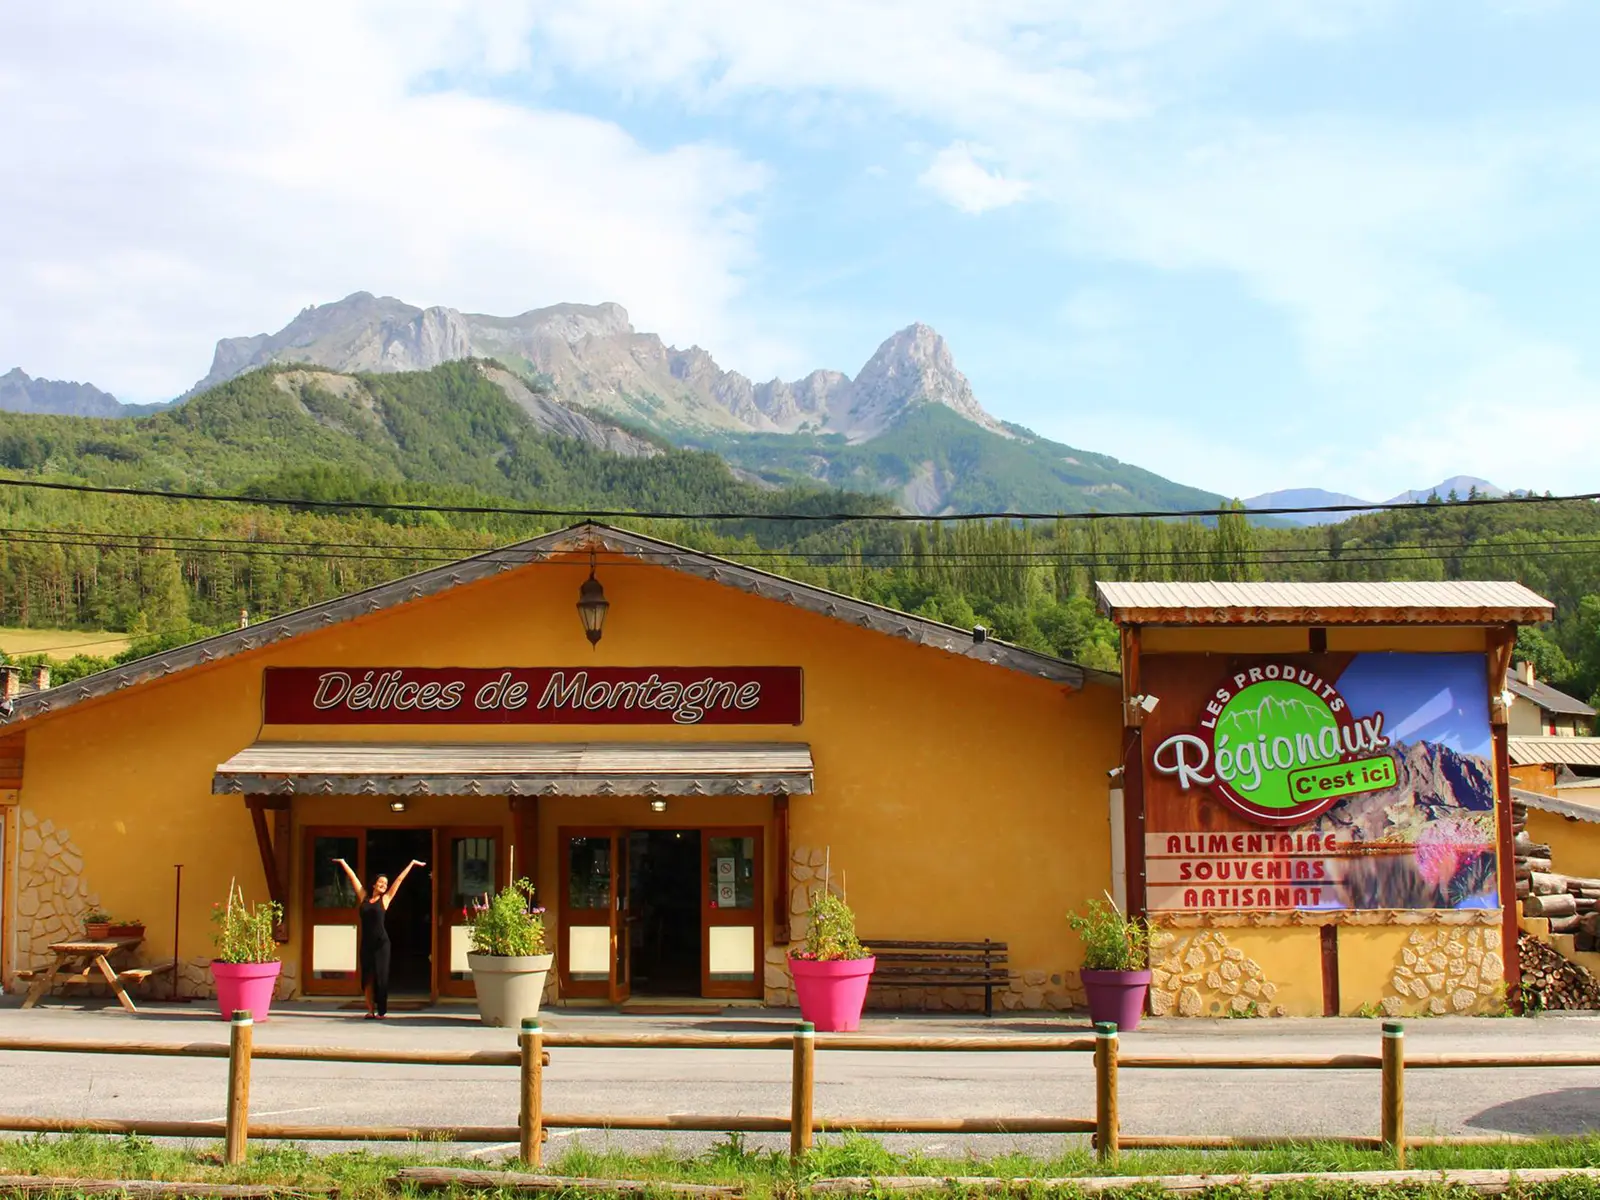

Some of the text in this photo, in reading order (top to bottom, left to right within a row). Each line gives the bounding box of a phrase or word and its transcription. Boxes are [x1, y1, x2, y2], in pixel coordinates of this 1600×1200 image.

[312, 670, 761, 724] Délices de Montagne
[1201, 664, 1346, 729] LES PRODUITS
[1153, 714, 1388, 790] Régionaux
[1295, 763, 1390, 795] C'est ici
[1166, 833, 1338, 854] ALIMENTAIRE
[1179, 860, 1326, 881] SOUVENIRS
[1183, 887, 1322, 908] ARTISANAT
